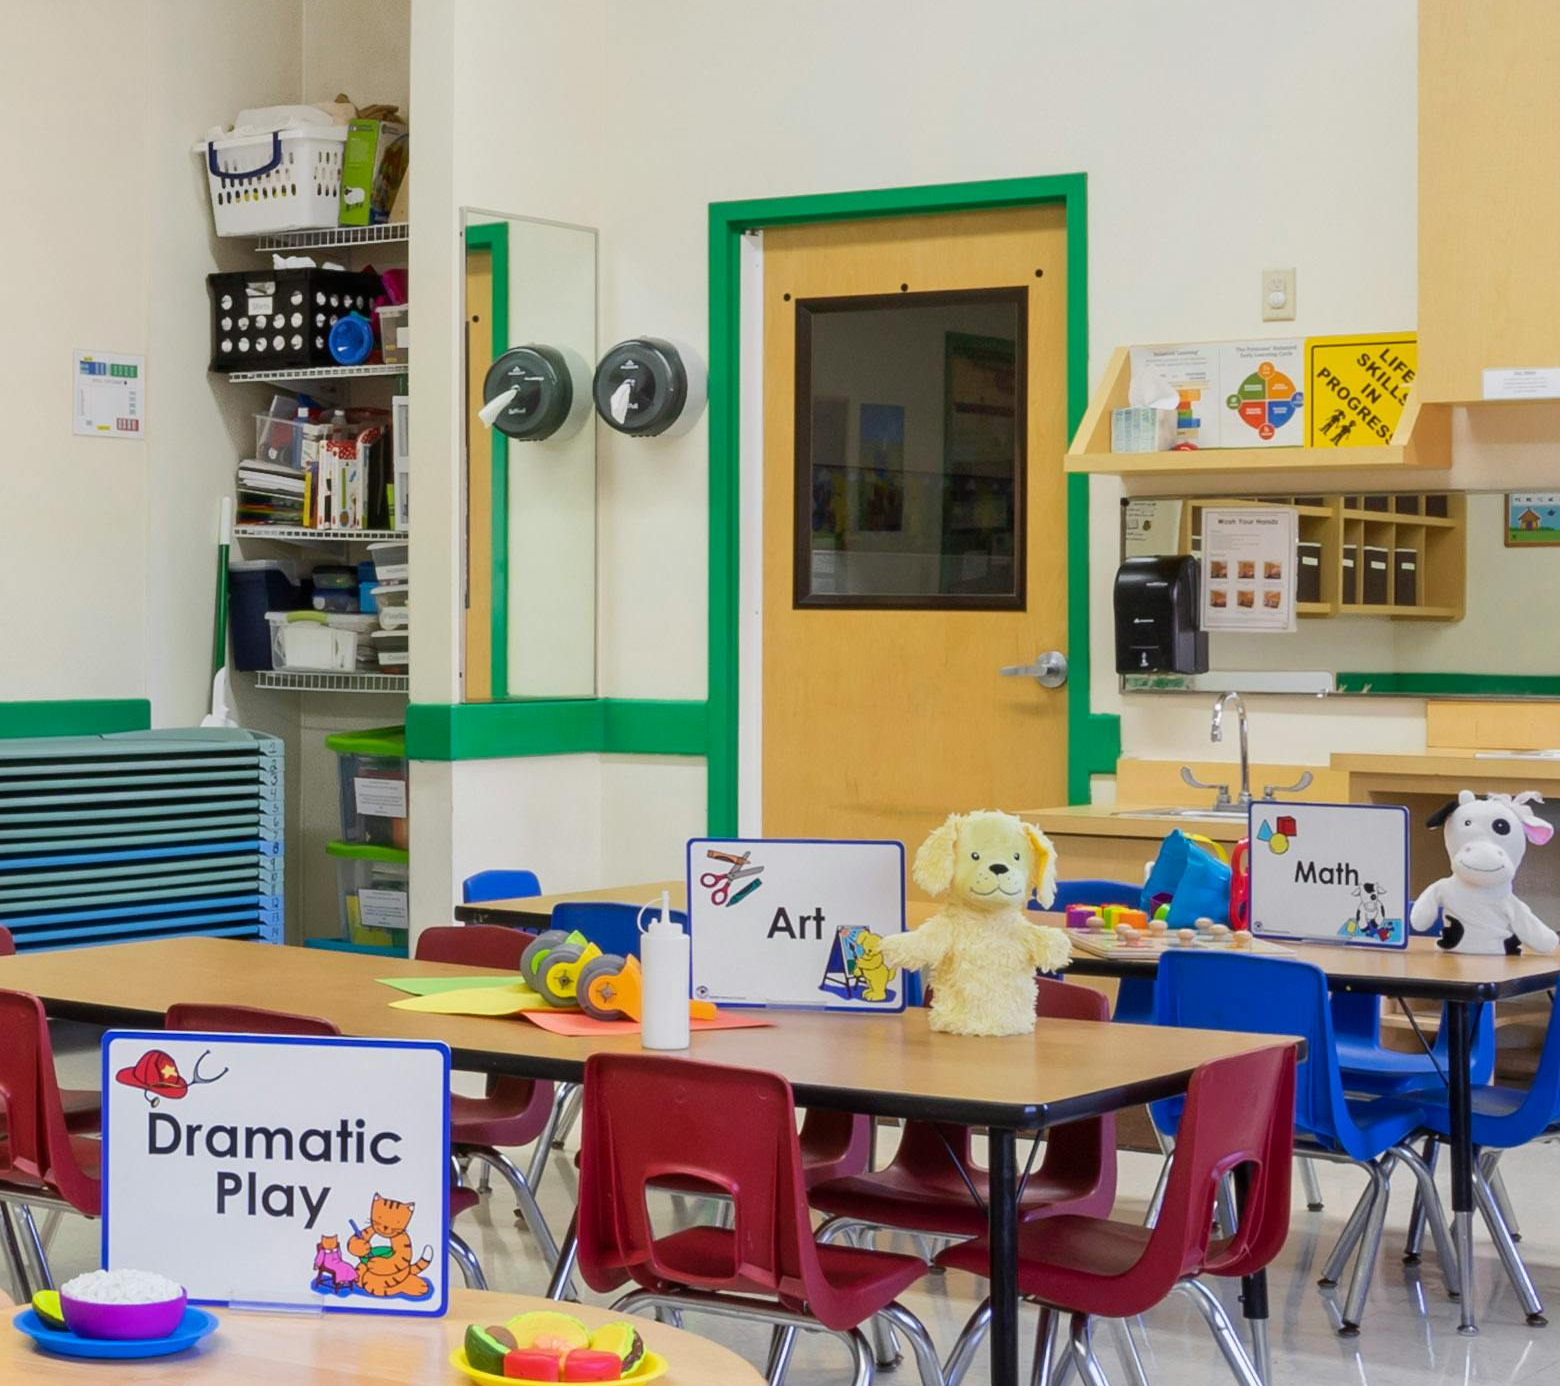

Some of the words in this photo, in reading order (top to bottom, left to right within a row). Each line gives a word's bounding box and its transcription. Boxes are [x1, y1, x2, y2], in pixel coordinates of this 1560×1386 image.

[1379, 348, 1416, 383] LIFE
[1360, 383, 1382, 405] IN
[1294, 860, 1360, 887] Math
[767, 906, 826, 941] Art
[147, 1111, 403, 1166] Dramatic
[216, 1170, 331, 1230] Play
